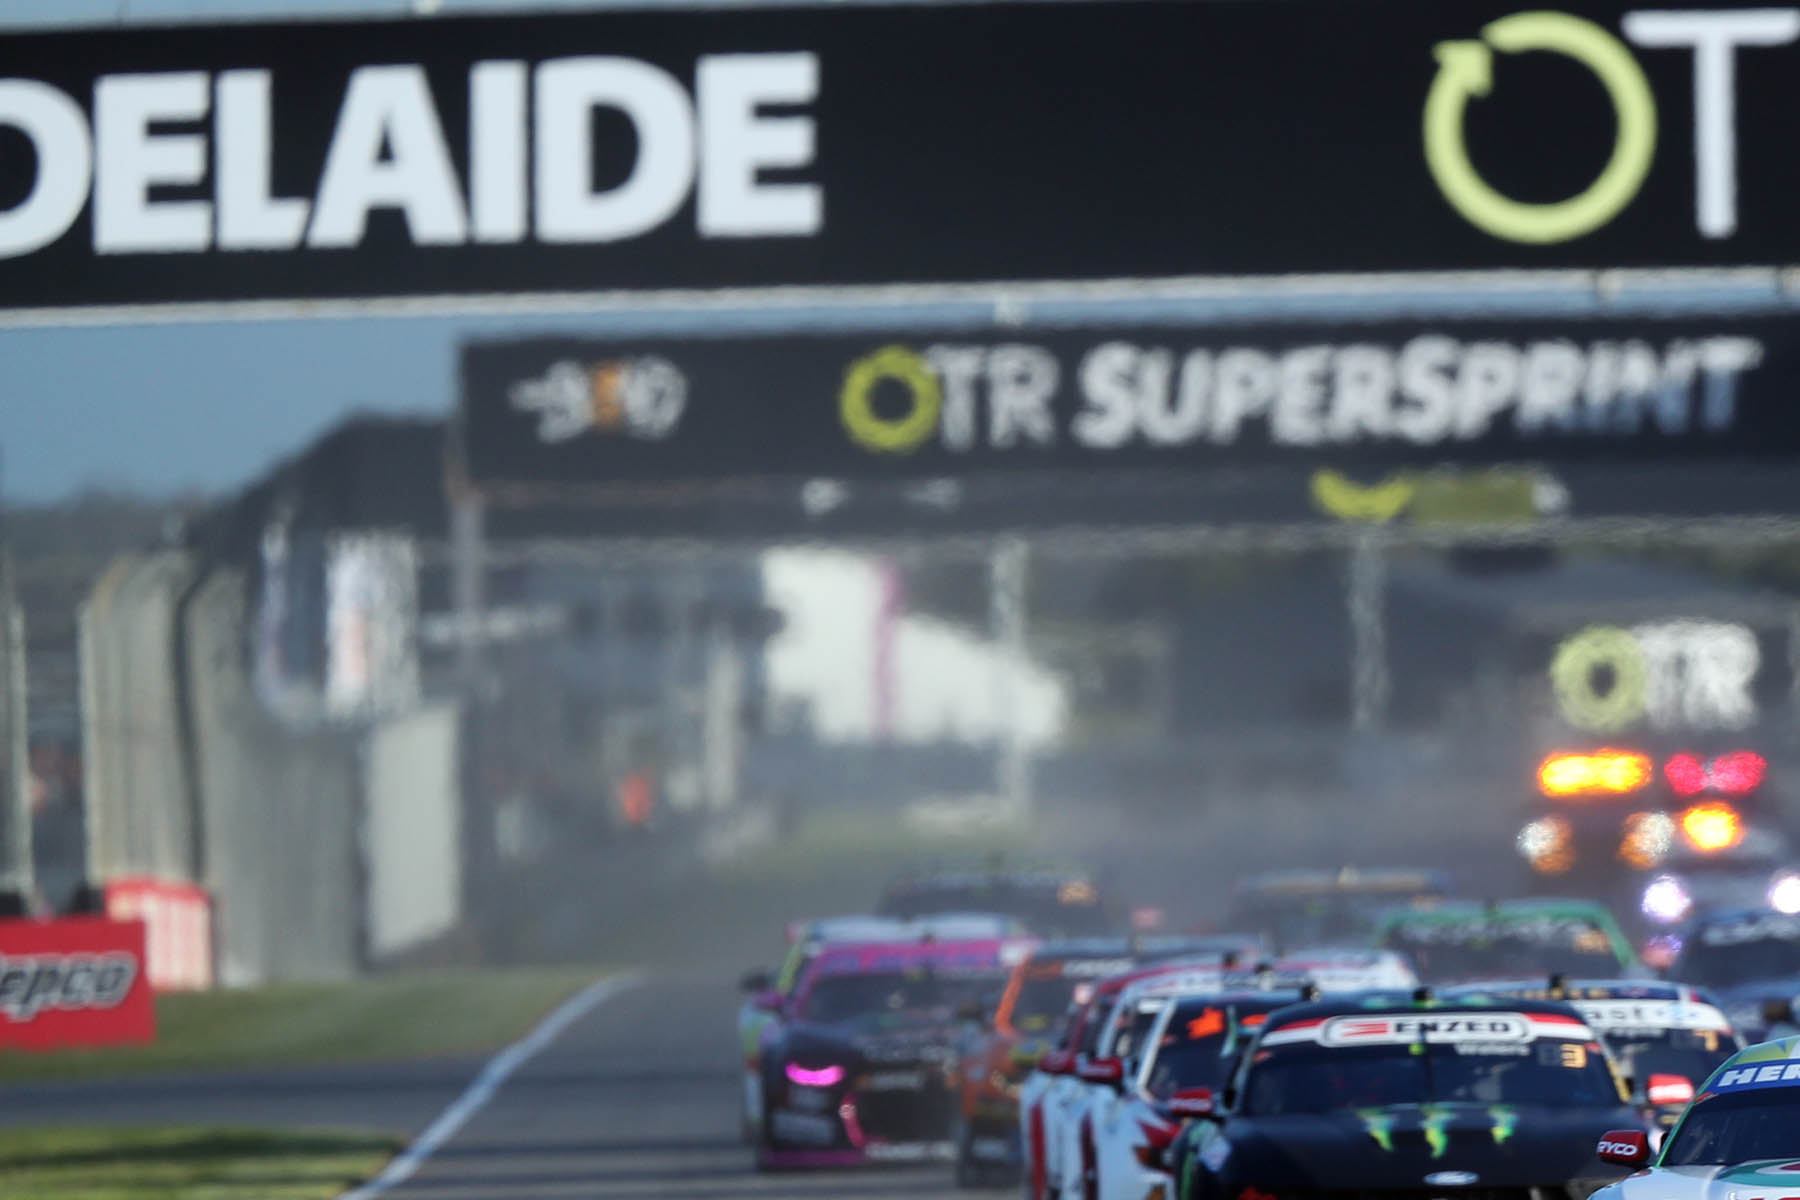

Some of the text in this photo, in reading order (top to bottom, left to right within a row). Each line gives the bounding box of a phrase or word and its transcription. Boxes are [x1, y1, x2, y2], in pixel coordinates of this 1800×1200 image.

[840, 335, 1762, 452] OTR SUPERSPRINT
[1552, 617, 1760, 733] OTR
